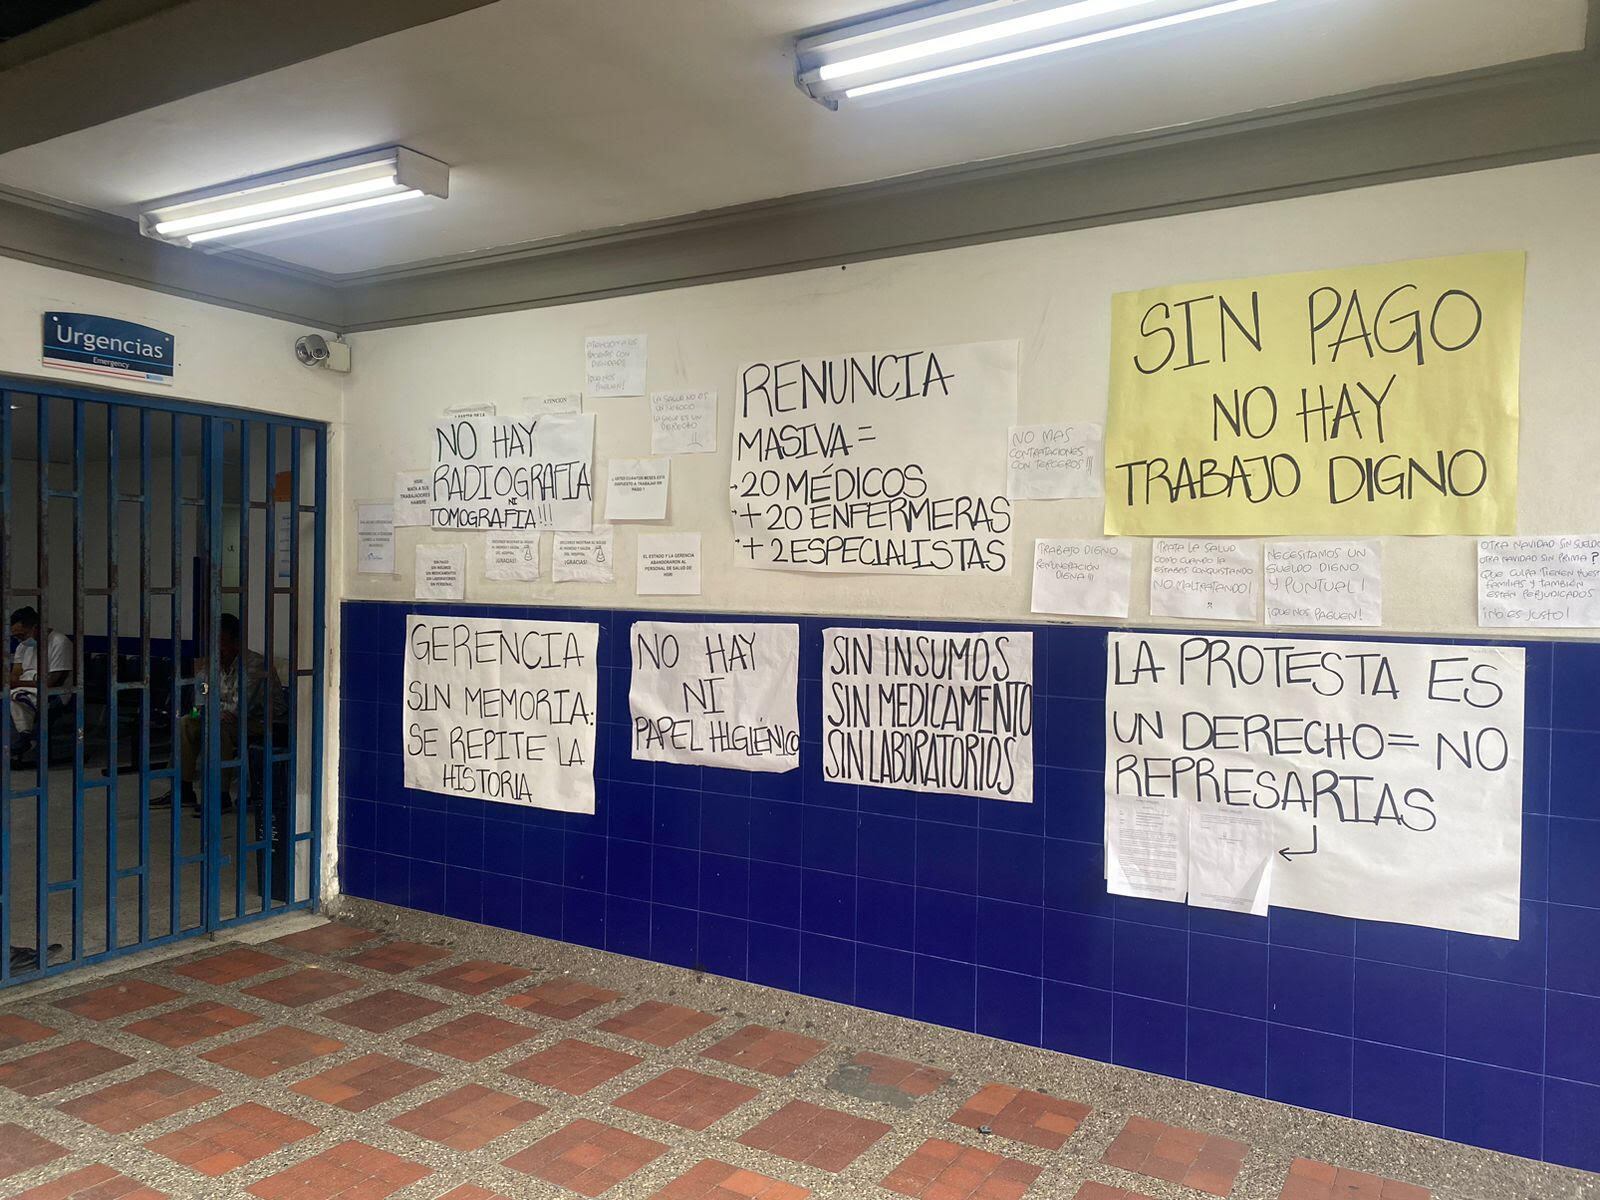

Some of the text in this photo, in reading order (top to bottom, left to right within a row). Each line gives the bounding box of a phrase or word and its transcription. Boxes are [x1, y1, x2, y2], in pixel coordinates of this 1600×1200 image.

[57, 324, 164, 358] Urgencias
[1133, 283, 1483, 375] SIN PAGO
[92, 356, 130, 370] Emergency
[742, 351, 955, 418] RENUNCIA
[1212, 373, 1397, 443] NO HAY
[436, 421, 537, 462] NO HAY
[1009, 446, 1085, 459] CONTRATACIONES
[1012, 426, 1074, 447] NO MAS
[433, 461, 592, 501] RADIOGRAFIA
[1010, 460, 1031, 470] CON
[1115, 448, 1487, 506] TRABAJO DIGNO
[508, 497, 518, 505] NI
[740, 463, 927, 505] 20 MÉDICOS
[766, 504, 802, 530] 20
[809, 495, 1011, 533] ENFERMERAS
[770, 538, 788, 562] 2
[790, 535, 1006, 572] ESPECIALISTAS
[1037, 543, 1119, 556] TRABAJO DIGNO
[1154, 556, 1178, 564] COMO
[1179, 556, 1213, 565] CUANDO
[1188, 543, 1200, 553] LA
[1204, 542, 1236, 553] SALUD
[1267, 547, 1366, 561] NECESITAMOS UN
[1479, 555, 1499, 564] OTRA
[1502, 554, 1537, 562] NAVIDAD
[1541, 554, 1554, 562] SIN
[1480, 540, 1509, 550] OTRA
[1513, 539, 1555, 549] NAVIDAD
[1560, 538, 1572, 549] SIN
[1153, 579, 1173, 590] NO
[1191, 566, 1253, 576] CONQUISTANDO
[1266, 563, 1360, 574] SUELDO DIGNO
[1480, 569, 1504, 579] QUE
[1540, 566, 1574, 577] TIENEN
[1292, 608, 1310, 617] NOS
[1522, 588, 1596, 601] PERJUDICADOS
[1507, 609, 1523, 618] ES
[411, 623, 584, 669] GERENCIA
[637, 632, 756, 673] NO HAY
[830, 633, 1010, 682] SIN INSUMOS
[1114, 637, 1504, 708] LA PROTESTA ES
[407, 680, 451, 711] SIN
[682, 677, 725, 714] NI
[827, 681, 1032, 737] SIN MEDICAMENTO
[408, 723, 585, 767] SE REPITE LA
[635, 716, 799, 757] PAPEL HIGIÉNICO
[1113, 710, 1164, 745] UN
[1436, 727, 1508, 772] NO
[825, 729, 1016, 795] SIN LABORATORIOS
[443, 763, 532, 802] HISTORIA
[1116, 753, 1437, 832] REPRESARIAS
